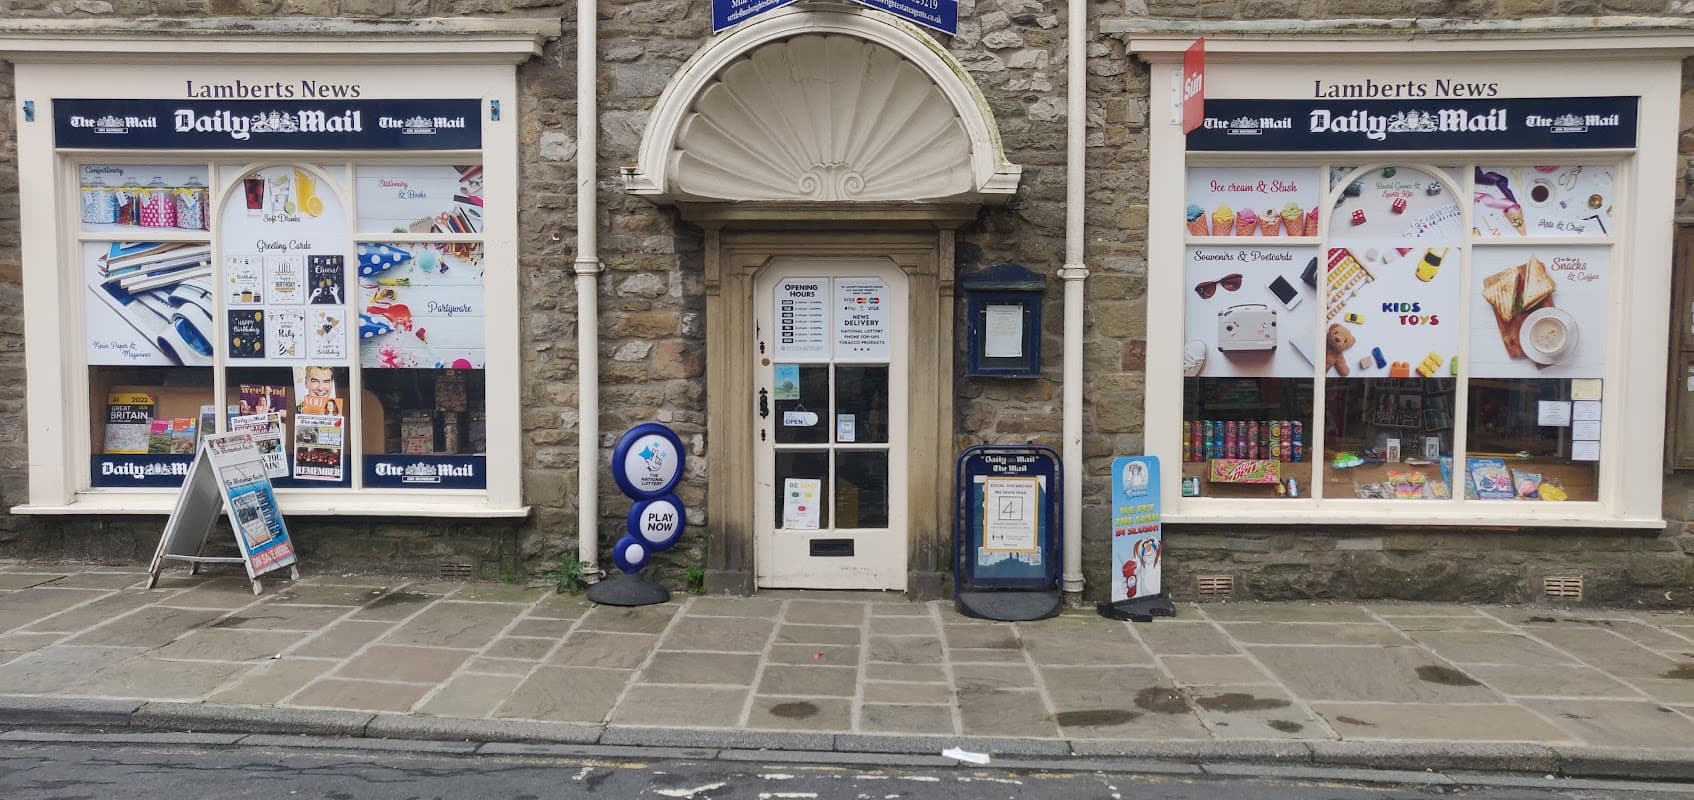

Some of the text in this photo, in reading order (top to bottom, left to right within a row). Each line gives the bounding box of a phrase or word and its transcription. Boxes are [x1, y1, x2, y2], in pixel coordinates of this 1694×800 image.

[186, 80, 361, 98] Lamberts News
[1184, 72, 1203, 101] Sun
[1314, 79, 1499, 98] Lamberts News
[70, 116, 158, 129] The Mail
[174, 109, 362, 141] Daily Mail
[379, 116, 466, 129] The Mail
[1203, 117, 1292, 129] The Mail
[1309, 108, 1508, 140] Daily Mail
[1526, 114, 1619, 127] The Mail
[1210, 179, 1298, 195] Ice cream & Slush
[398, 189, 427, 200] & Books
[263, 213, 301, 223] Soft Drinks
[1555, 220, 1566, 232] &
[256, 239, 312, 253] Greeting Cards
[1193, 250, 1293, 263] Souvenirs & Postcards
[1551, 256, 1588, 271] Snacks
[1567, 271, 1577, 282] &
[789, 290, 815, 298] HOURS
[427, 300, 473, 317] Partyware
[1382, 302, 1421, 312] KIDS
[1399, 315, 1440, 326] TOYS
[110, 411, 148, 420] BRITAIN
[984, 455, 1035, 465] Daily Mail
[102, 461, 145, 479] Daily
[296, 466, 341, 476] REMEMBER
[375, 462, 474, 477] The Mail
[992, 464, 1027, 473] The Mail
[1001, 500, 1016, 519] 4
[648, 513, 673, 522] PLAY
[647, 523, 673, 531] NOW
